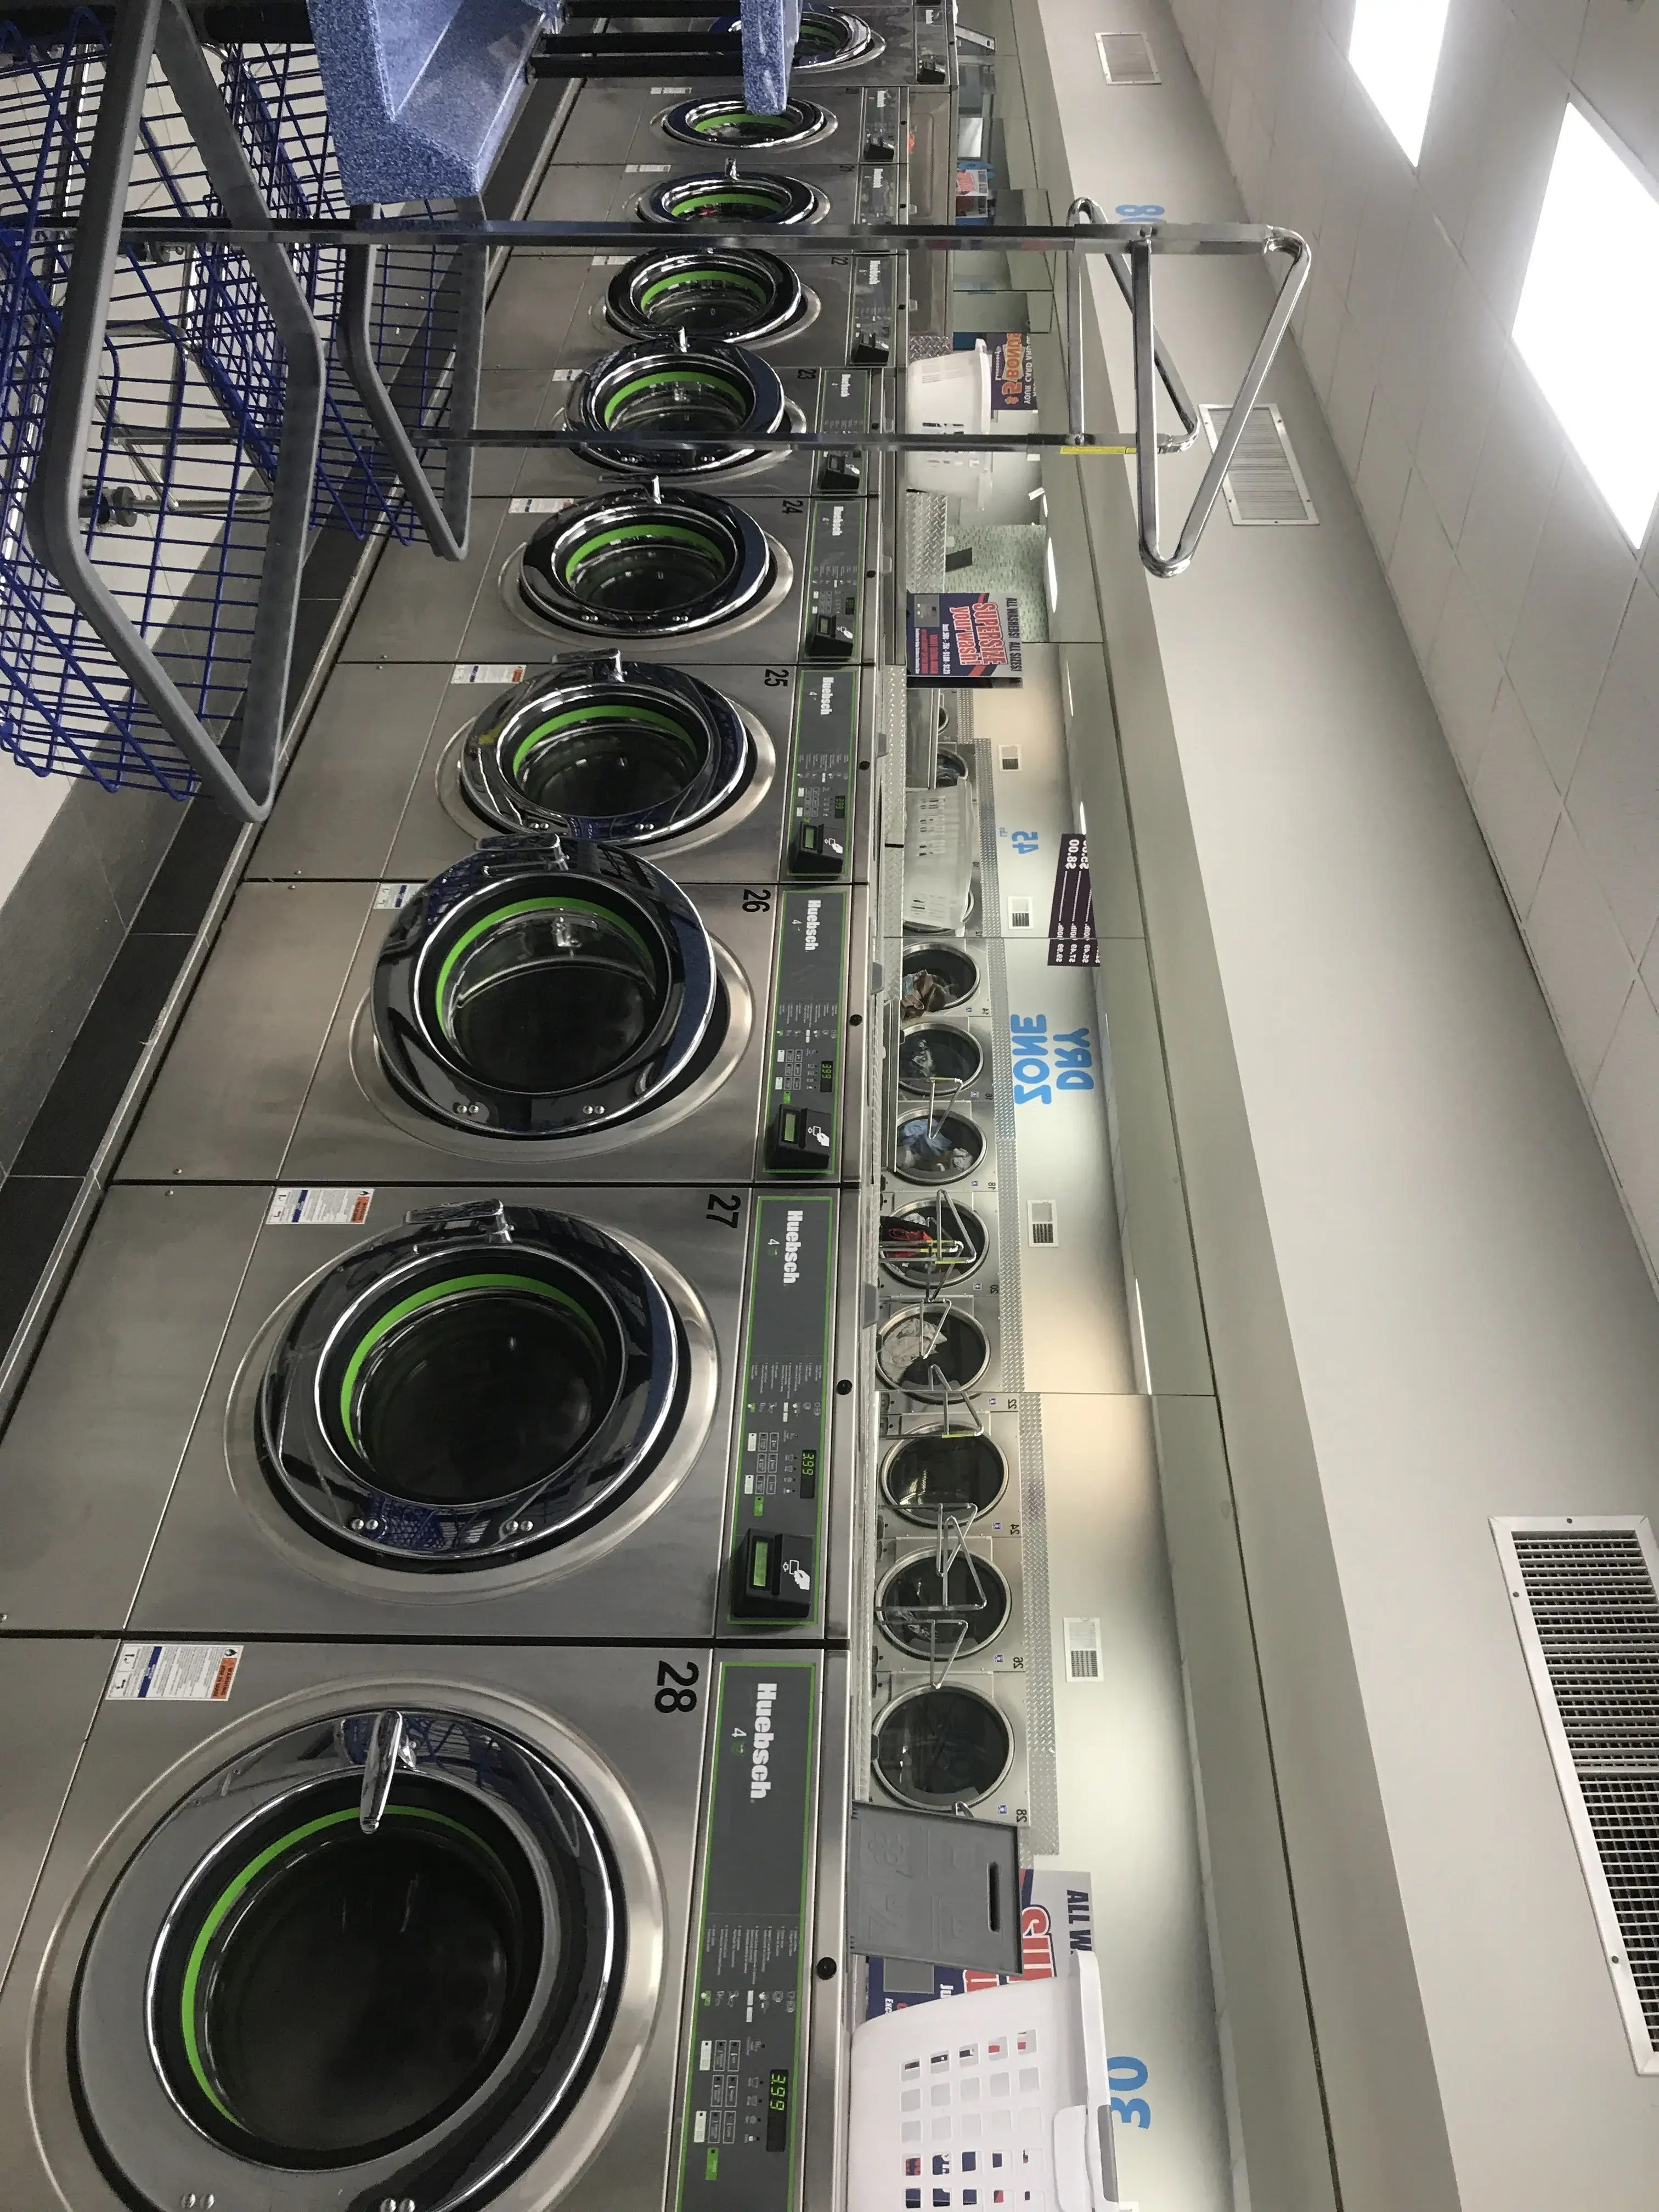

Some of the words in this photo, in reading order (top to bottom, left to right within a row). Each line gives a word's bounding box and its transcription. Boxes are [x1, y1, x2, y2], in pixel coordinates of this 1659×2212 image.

[1115, 205, 1165, 223] 8
[797, 369, 816, 380] 23
[782, 500, 804, 514] 24
[1006, 597, 1017, 607] ALL
[950, 606, 973, 631] your
[1007, 608, 1019, 639] WASHERS!
[972, 602, 1008, 665] SUPERSIZE
[1009, 642, 1020, 652] ALL
[955, 631, 981, 665] wash!
[1009, 653, 1022, 672] SIZES!
[764, 669, 789, 687] 25
[820, 677, 834, 715] Huebsch
[742, 889, 771, 912] 26
[804, 900, 821, 951] Huebsch
[706, 1193, 741, 1229] 27
[783, 1210, 803, 1284] Huebsch
[654, 1661, 699, 1714] 28
[731, 1728, 747, 1737] 4
[750, 1683, 777, 1799] Huebsch
[1066, 1889, 1090, 1924] ALL
